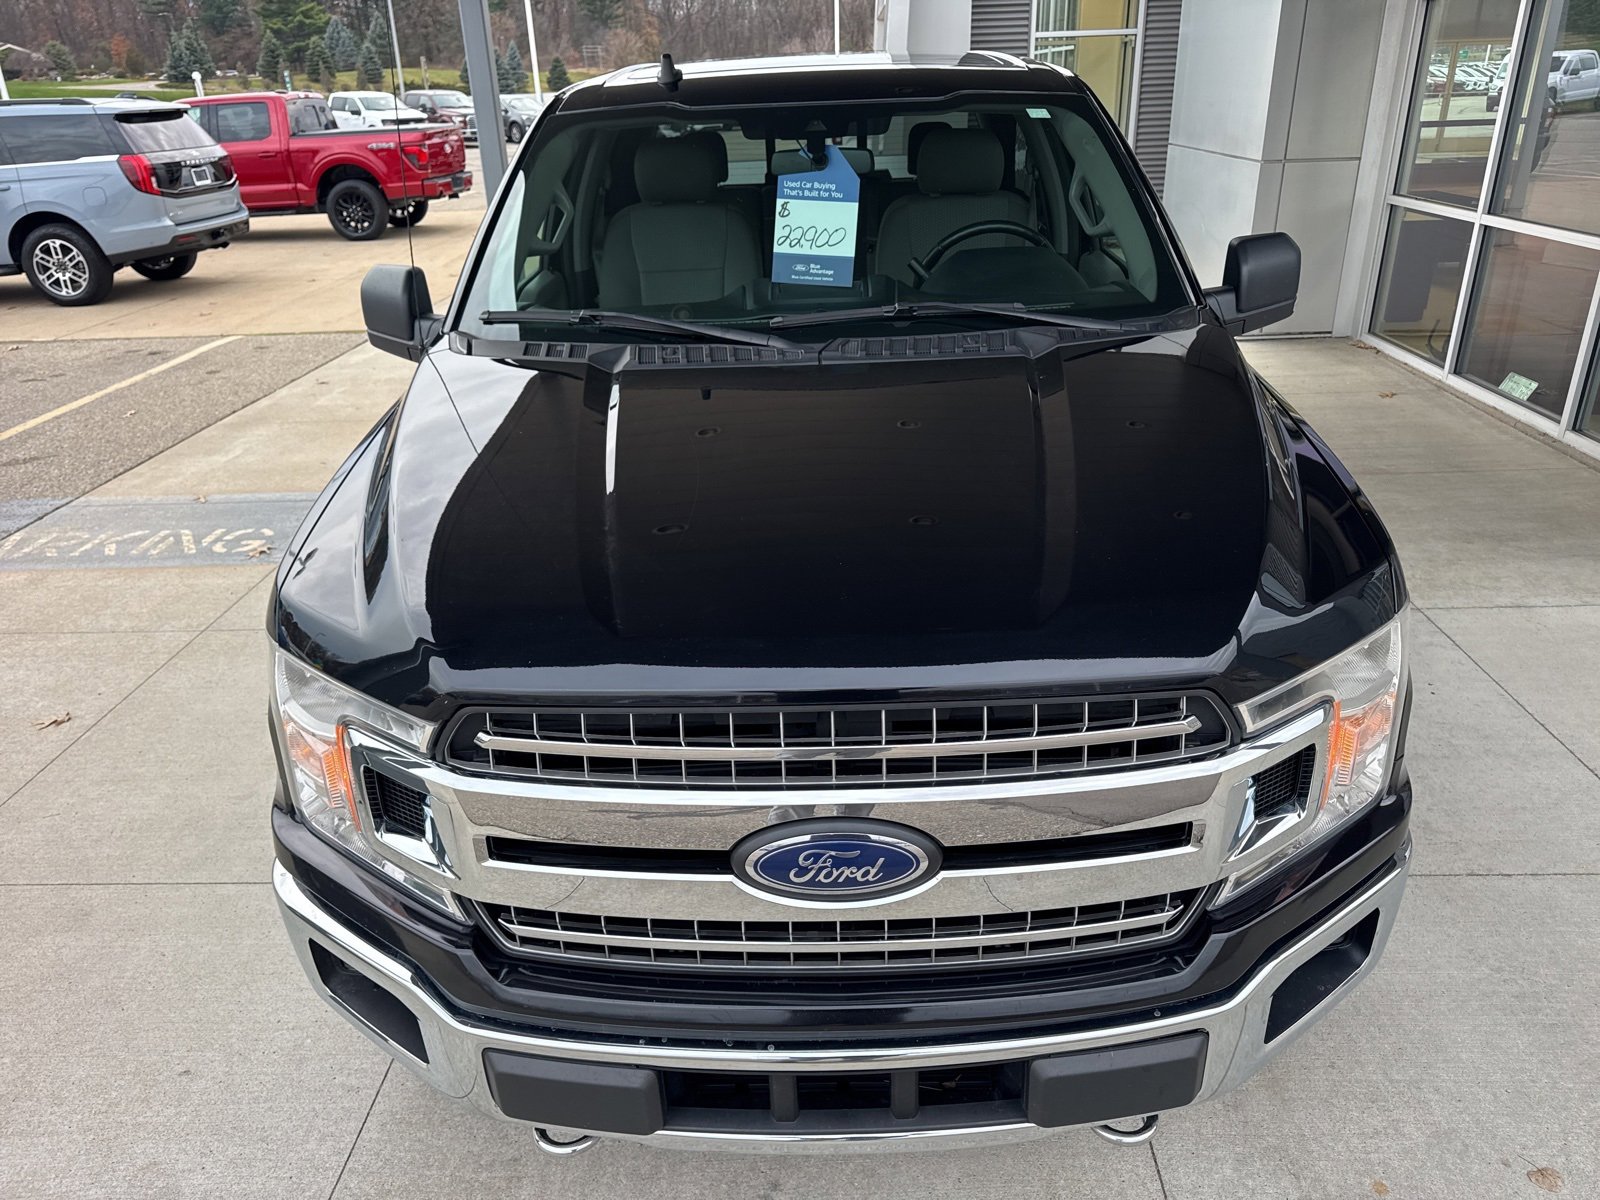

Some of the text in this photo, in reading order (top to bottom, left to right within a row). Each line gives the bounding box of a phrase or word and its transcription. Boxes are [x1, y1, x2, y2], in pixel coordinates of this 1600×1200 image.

[783, 180, 801, 188] Used
[813, 181, 836, 191] Buying
[783, 188, 803, 196] That's
[804, 189, 819, 197] Built
[820, 190, 829, 198] for
[778, 200, 791, 218] $
[788, 849, 885, 884] Ford
